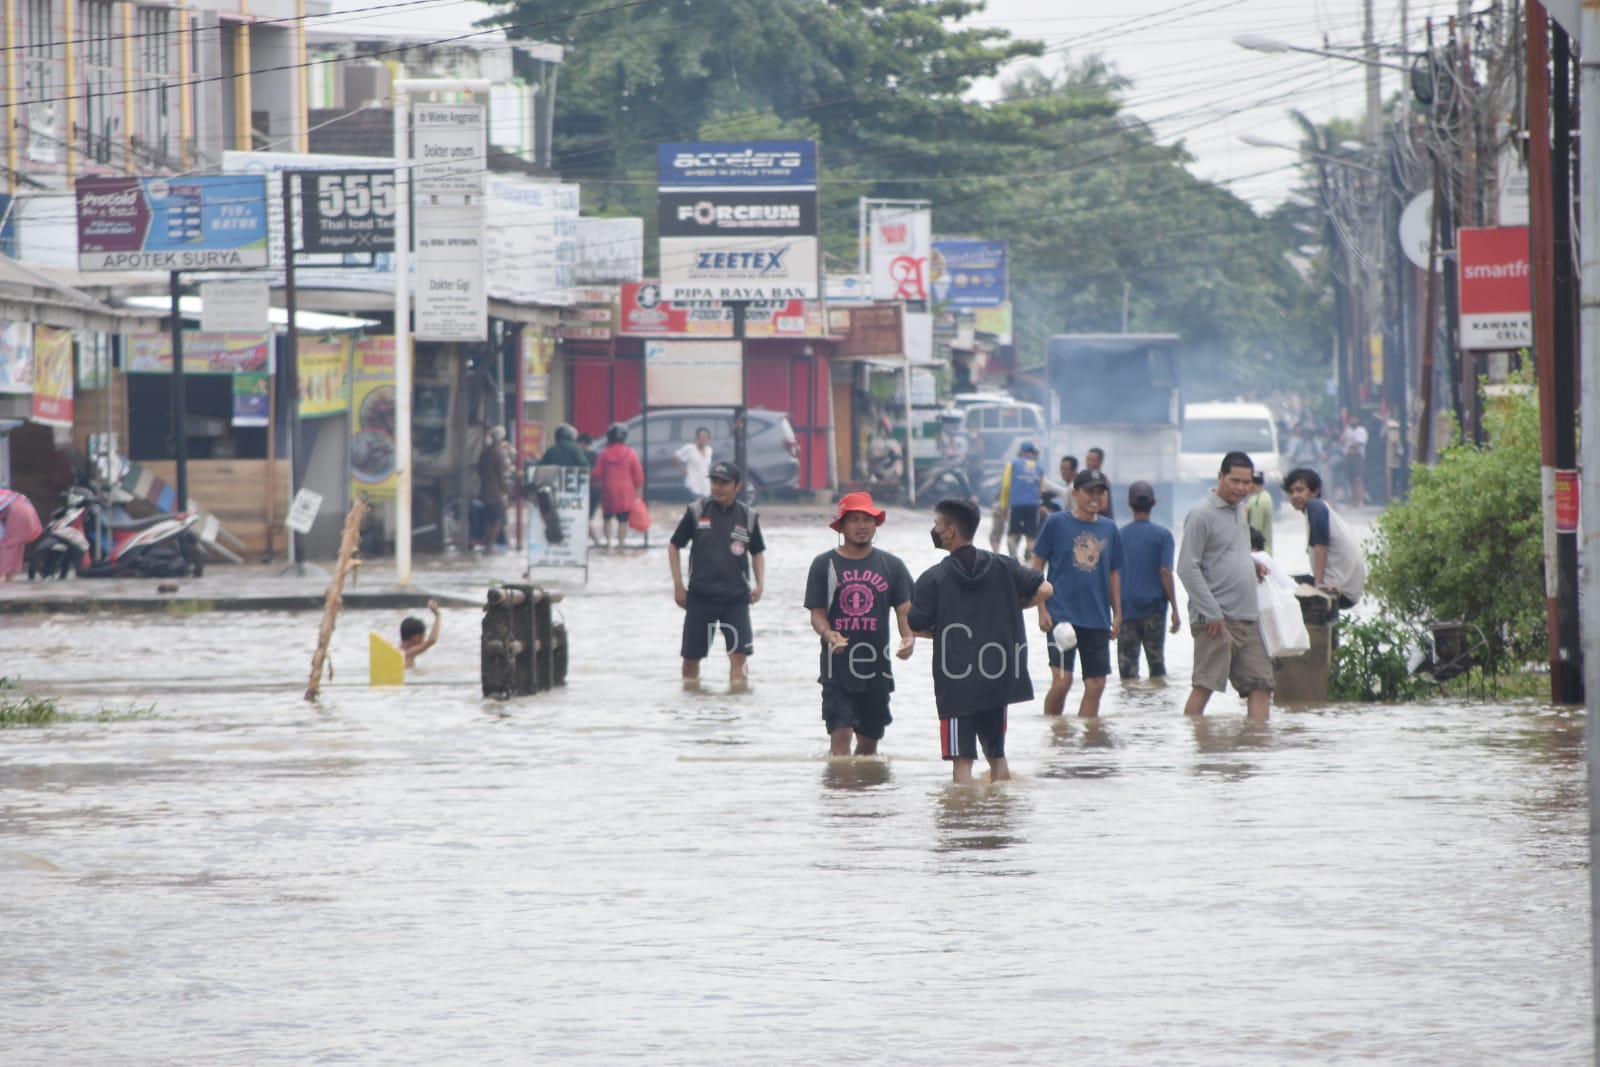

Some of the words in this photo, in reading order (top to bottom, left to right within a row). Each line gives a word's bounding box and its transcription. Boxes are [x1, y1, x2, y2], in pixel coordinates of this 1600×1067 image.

[424, 144, 449, 157] Dokter
[673, 148, 802, 168] accelera
[318, 174, 396, 218] 555
[677, 201, 800, 225] FORCEUM
[320, 219, 346, 230] Thai
[350, 219, 373, 230] Iced
[103, 252, 177, 268] APOTEK
[182, 251, 242, 266] SURYA
[696, 246, 788, 272] ZEETEX
[1464, 260, 1530, 279] smartfr
[429, 279, 454, 290] Dokter
[674, 288, 713, 298] PIPA
[720, 287, 764, 298] RAYA
[771, 287, 806, 298] BAN
[1472, 321, 1515, 330] KAWAN
[1496, 330, 1527, 341] CELL
[835, 617, 878, 631] STATE
